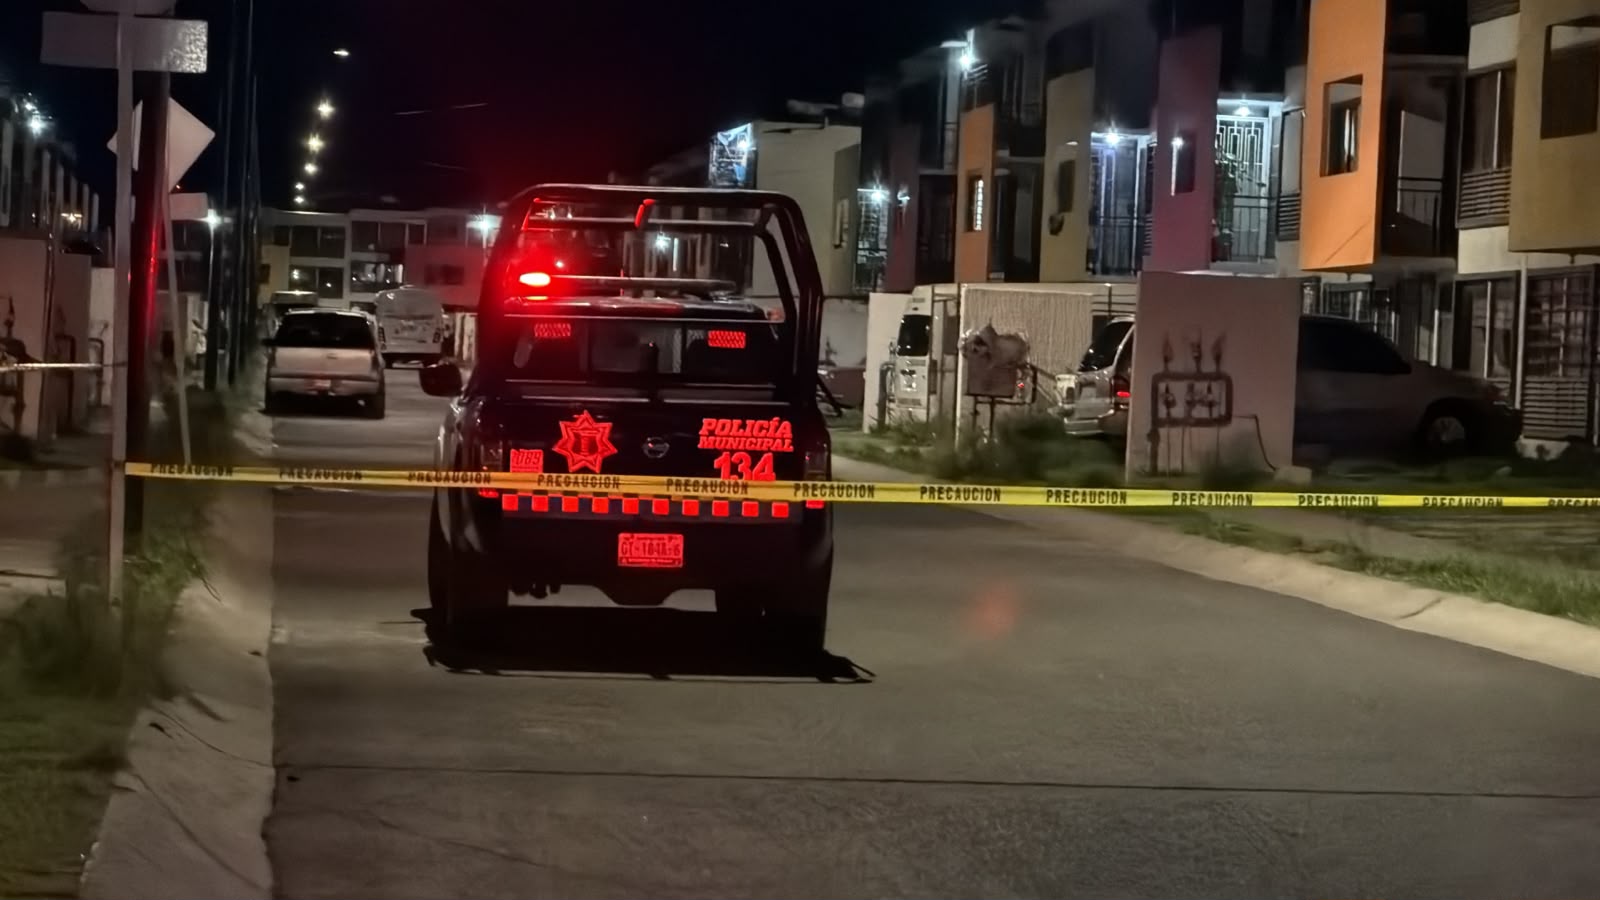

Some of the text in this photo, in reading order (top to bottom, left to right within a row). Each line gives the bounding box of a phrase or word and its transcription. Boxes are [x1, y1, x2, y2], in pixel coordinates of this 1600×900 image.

[699, 417, 793, 438] POLICÍA
[697, 436, 794, 452] MUNICIPAL
[713, 451, 776, 481] 134
[407, 471, 491, 484] PRECAUCION
[537, 474, 620, 490] PRECAUCION
[665, 478, 749, 495] PRECAUCION
[792, 483, 876, 499] PRECAUCION
[919, 486, 1001, 502] PRECAUCION
[1045, 489, 1128, 505] PRECAUCION
[1171, 492, 1253, 506] PRECAUCION
